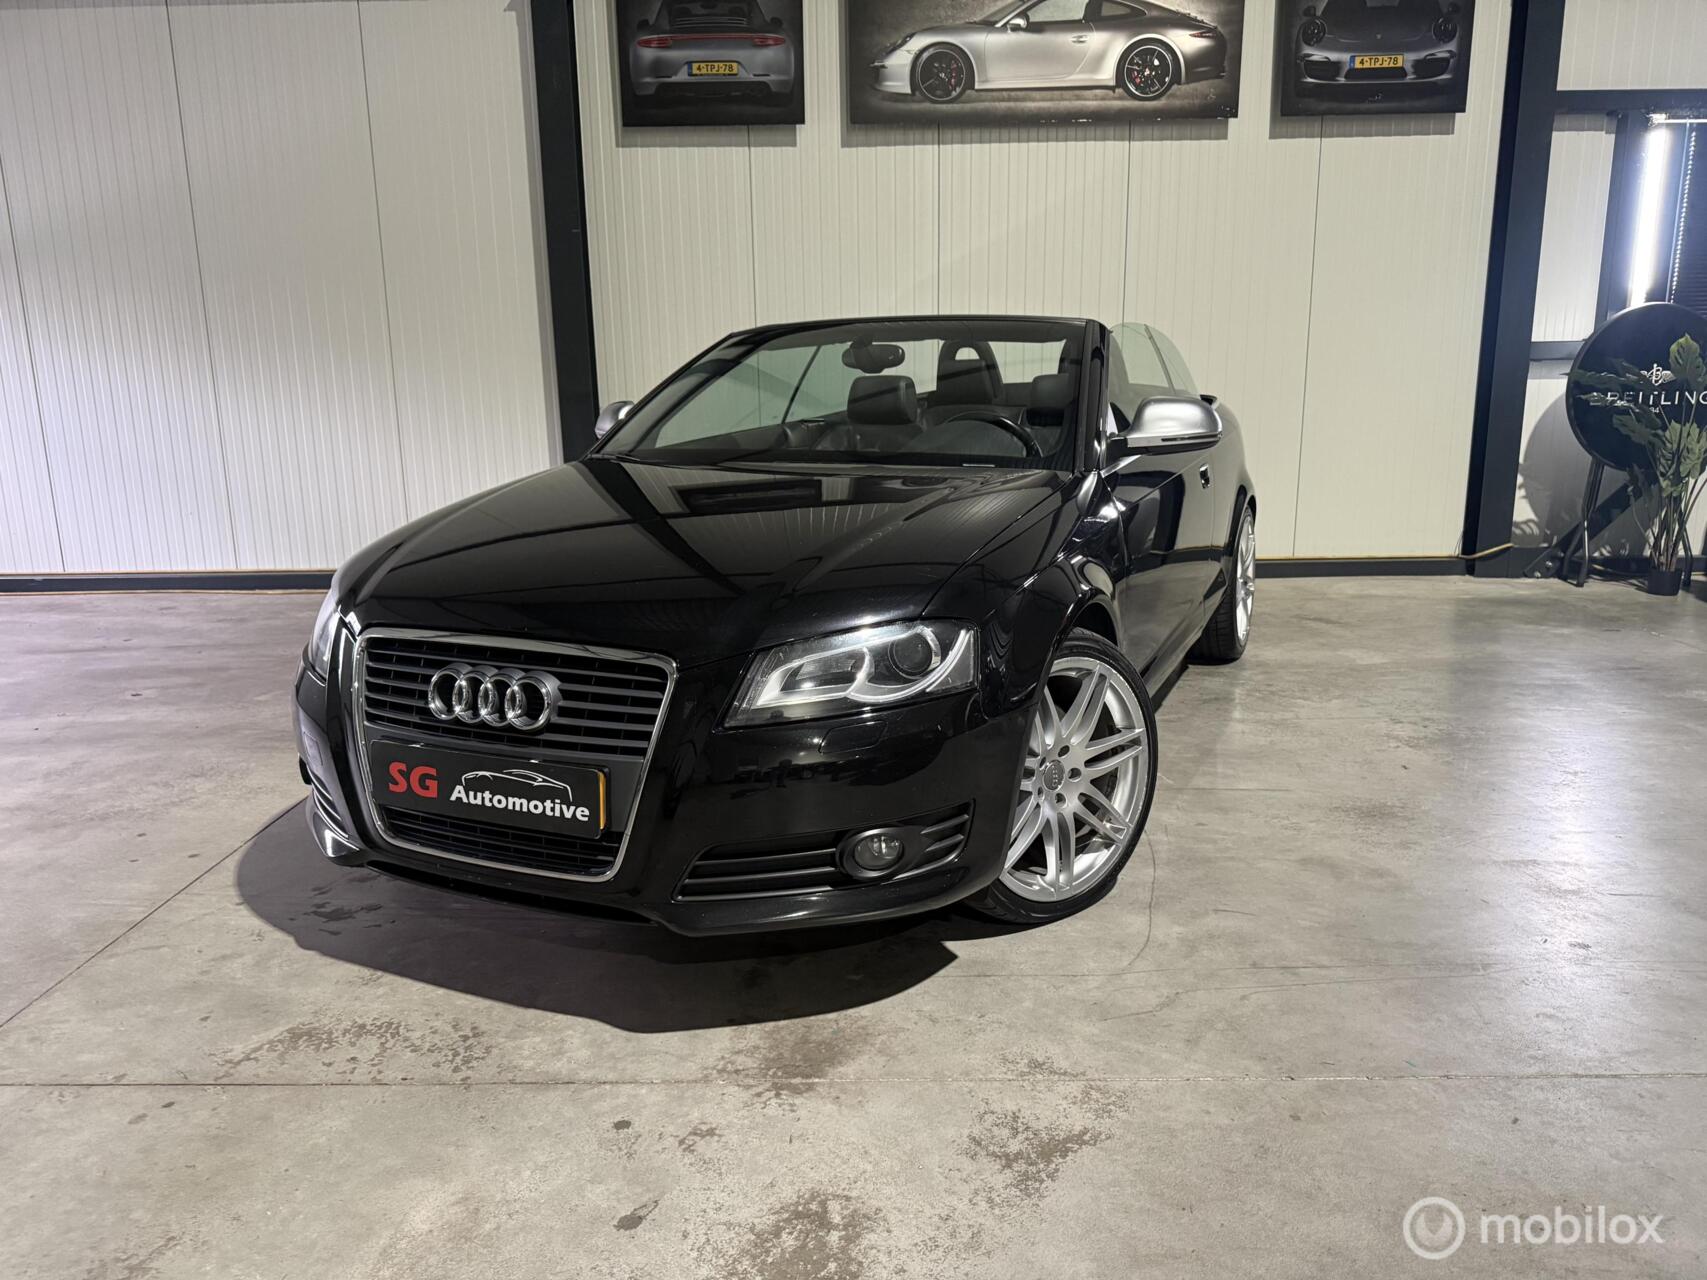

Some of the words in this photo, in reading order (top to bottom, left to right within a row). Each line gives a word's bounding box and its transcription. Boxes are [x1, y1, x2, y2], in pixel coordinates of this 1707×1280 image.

[1359, 56, 1399, 66] 4-TPJ-78
[696, 63, 734, 73] 4-TPJ-78
[388, 761, 438, 798] SG
[450, 785, 590, 821] Automotive
